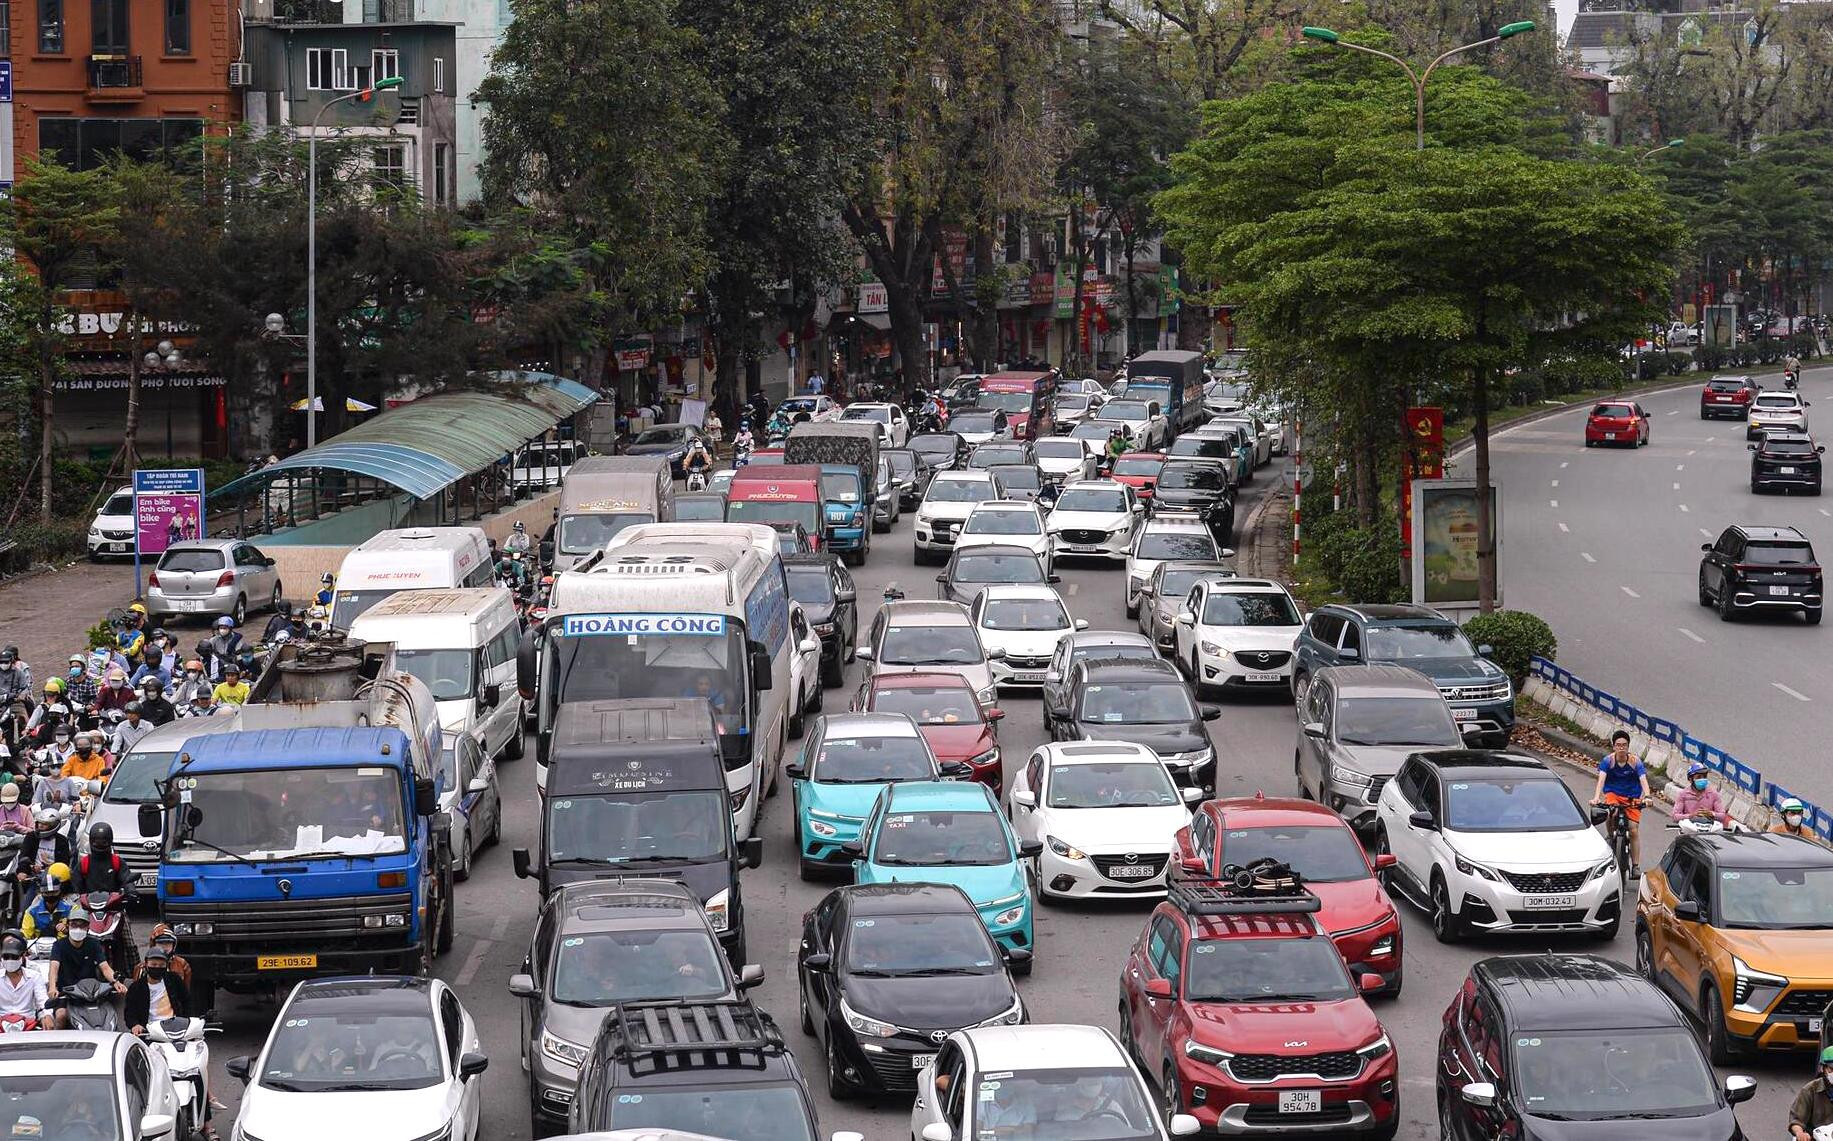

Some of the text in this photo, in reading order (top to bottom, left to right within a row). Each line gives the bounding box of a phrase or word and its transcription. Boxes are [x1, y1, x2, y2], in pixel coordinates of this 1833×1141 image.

[154, 498, 171, 506] bike
[139, 513, 160, 522] bike
[830, 511, 847, 521] HUY
[570, 617, 720, 633] HOÀNG CÔNG
[262, 957, 313, 968] 29E-109.62
[1291, 1092, 1310, 1102] 30H
[1283, 1102, 1317, 1112] 954.78
